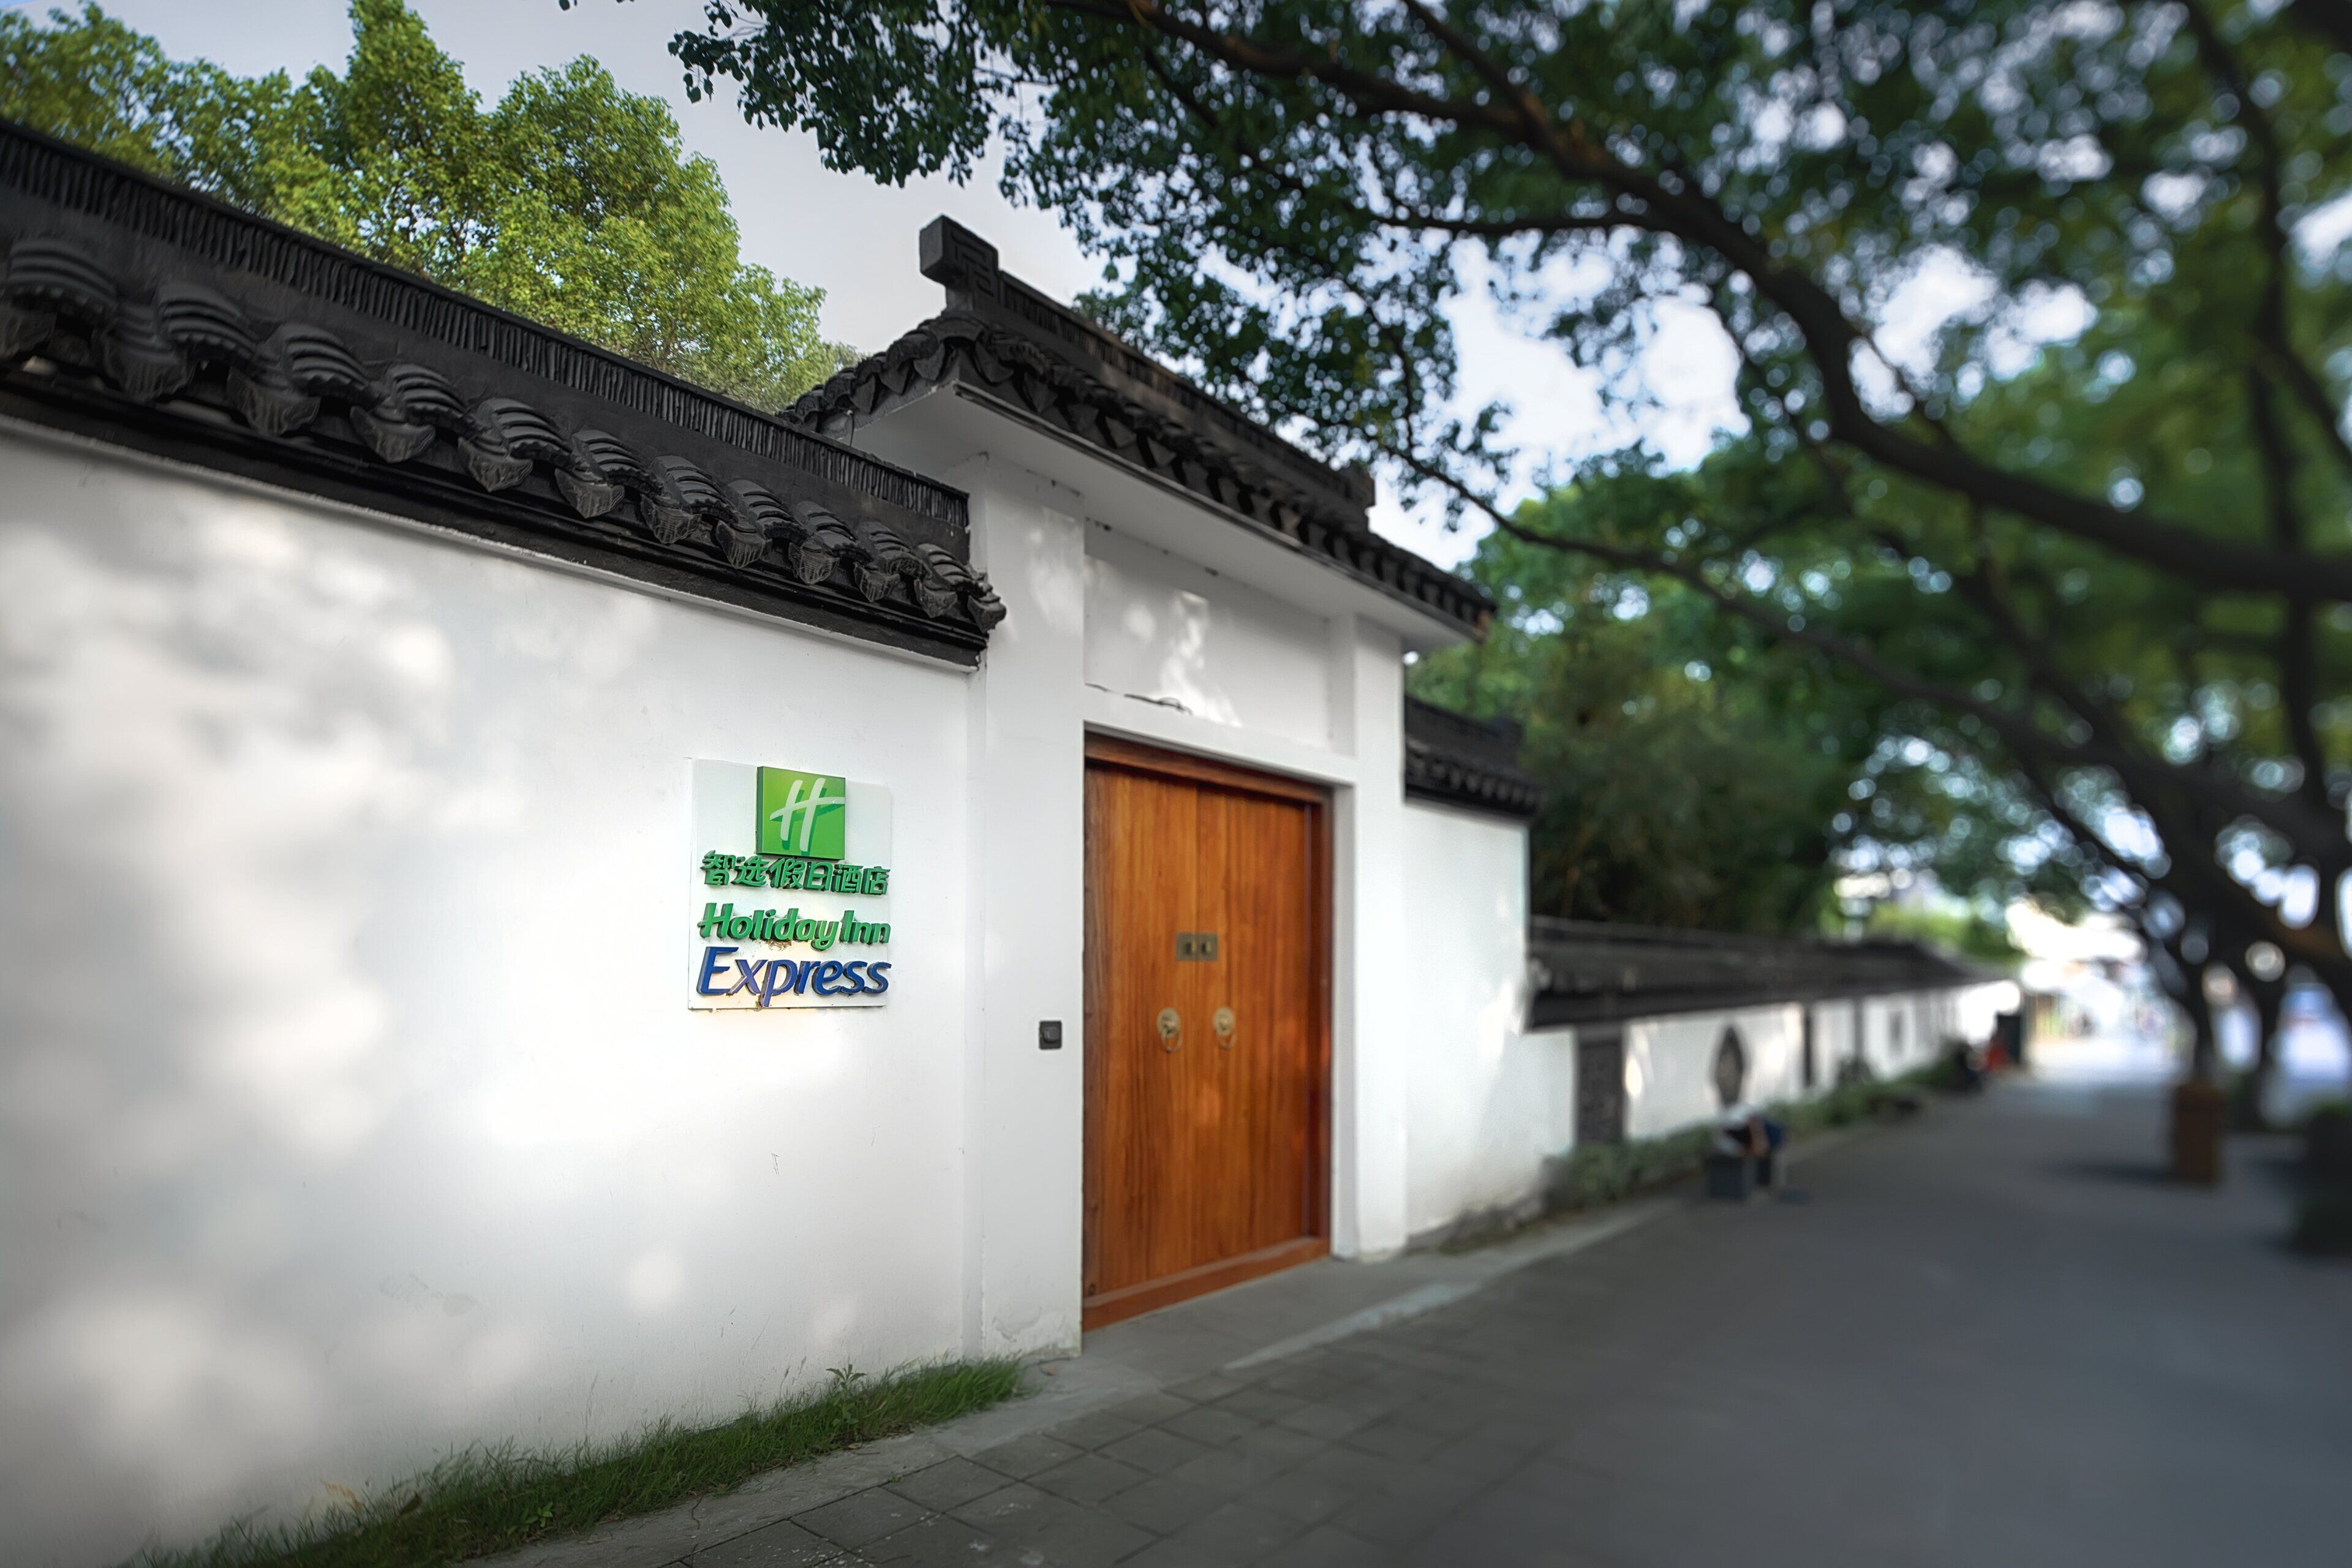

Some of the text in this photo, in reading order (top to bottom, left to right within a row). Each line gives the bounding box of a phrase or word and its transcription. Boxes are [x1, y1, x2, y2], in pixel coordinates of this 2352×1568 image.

[700, 850, 891, 895] 智选假日酒店
[697, 903, 891, 951] Holiday Inn
[696, 946, 891, 1007] Express
